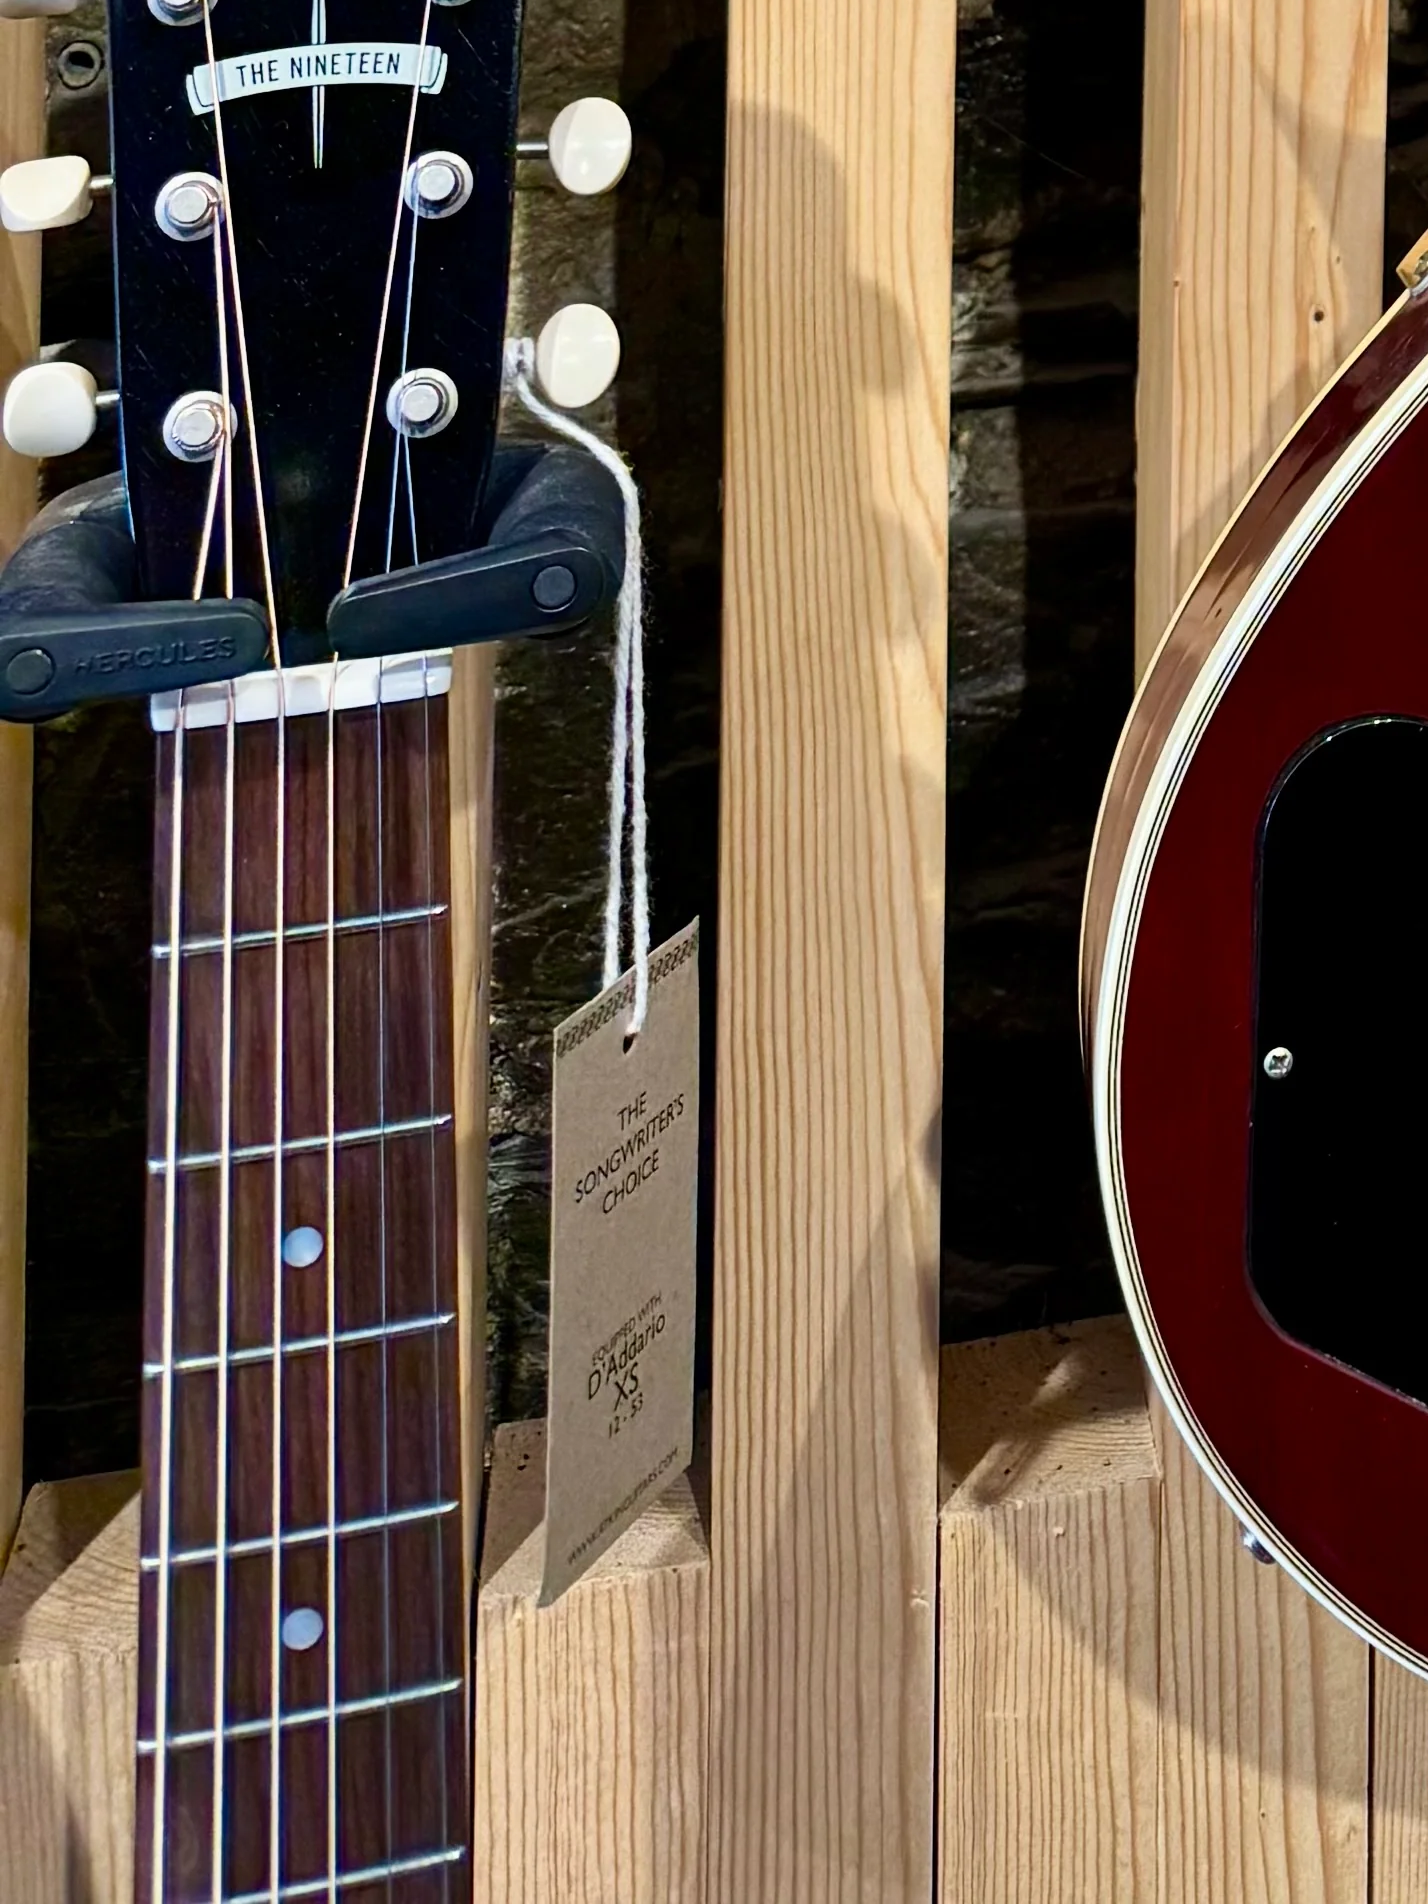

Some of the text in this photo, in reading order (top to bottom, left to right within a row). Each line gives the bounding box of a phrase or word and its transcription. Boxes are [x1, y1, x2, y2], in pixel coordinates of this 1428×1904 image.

[235, 51, 402, 88] THE NINETEEN
[73, 636, 237, 676] HERCULES
[616, 1090, 648, 1132] THE
[575, 1093, 685, 1204] SONGWRITER'S
[602, 1149, 660, 1215] CHOICE
[638, 1289, 662, 1323] WITH
[588, 1313, 667, 1401] D'Addario
[613, 1360, 640, 1413] XS
